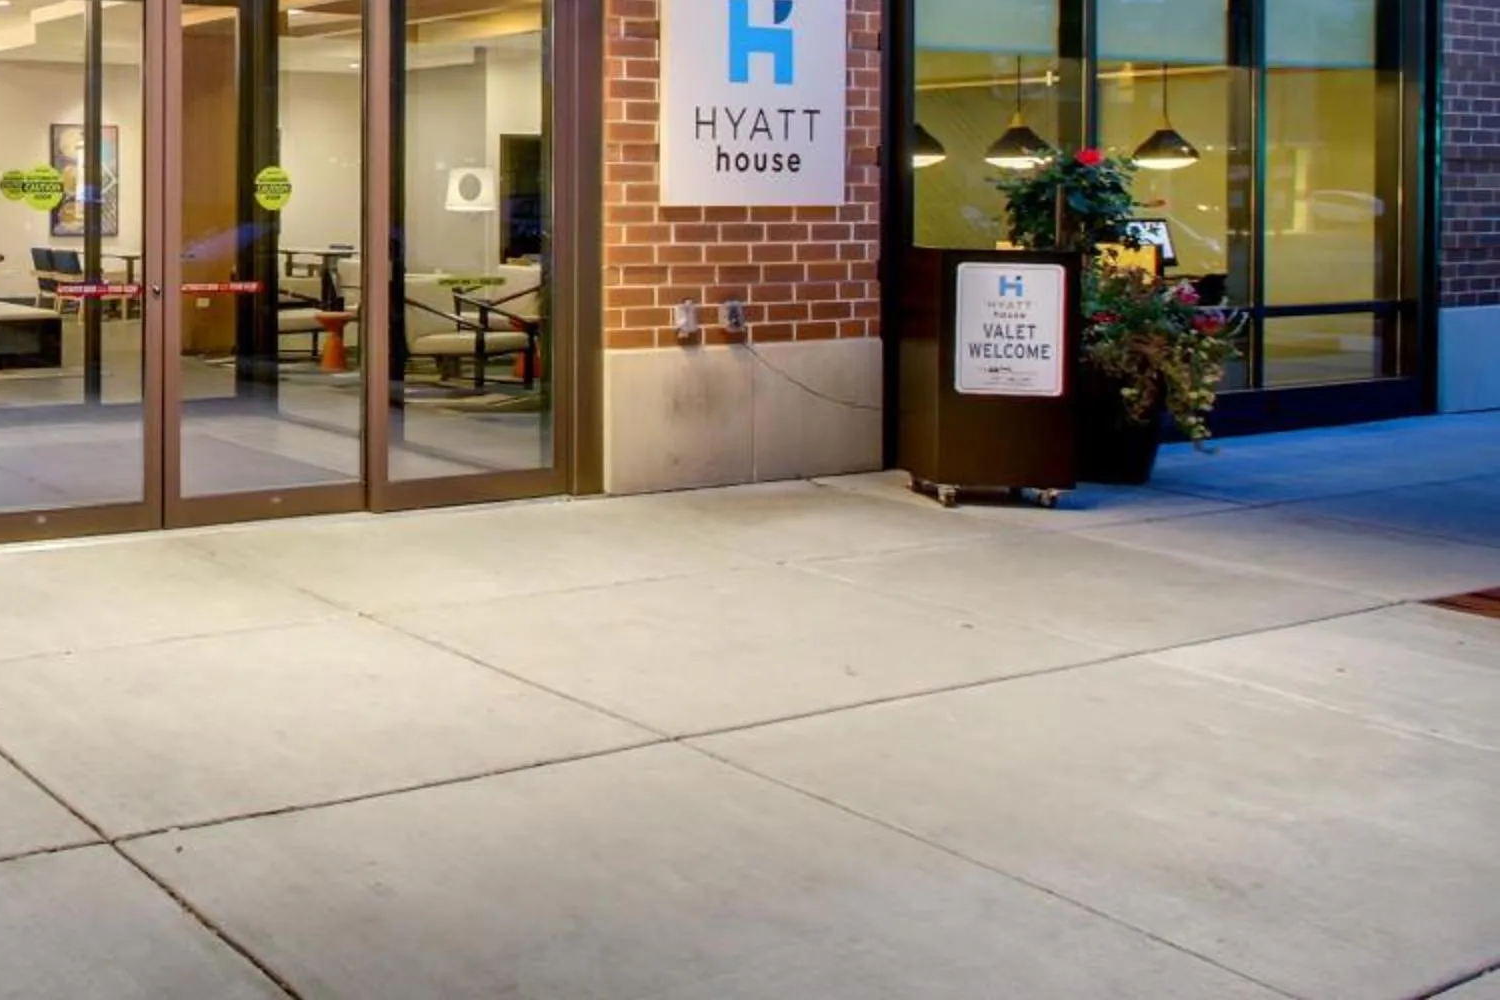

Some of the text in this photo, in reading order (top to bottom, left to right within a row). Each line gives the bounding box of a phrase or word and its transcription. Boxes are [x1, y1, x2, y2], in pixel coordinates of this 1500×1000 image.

[695, 105, 821, 143] HYATT
[716, 145, 802, 173] house
[983, 323, 1037, 340] VALET
[968, 343, 1052, 361] WELCOME
